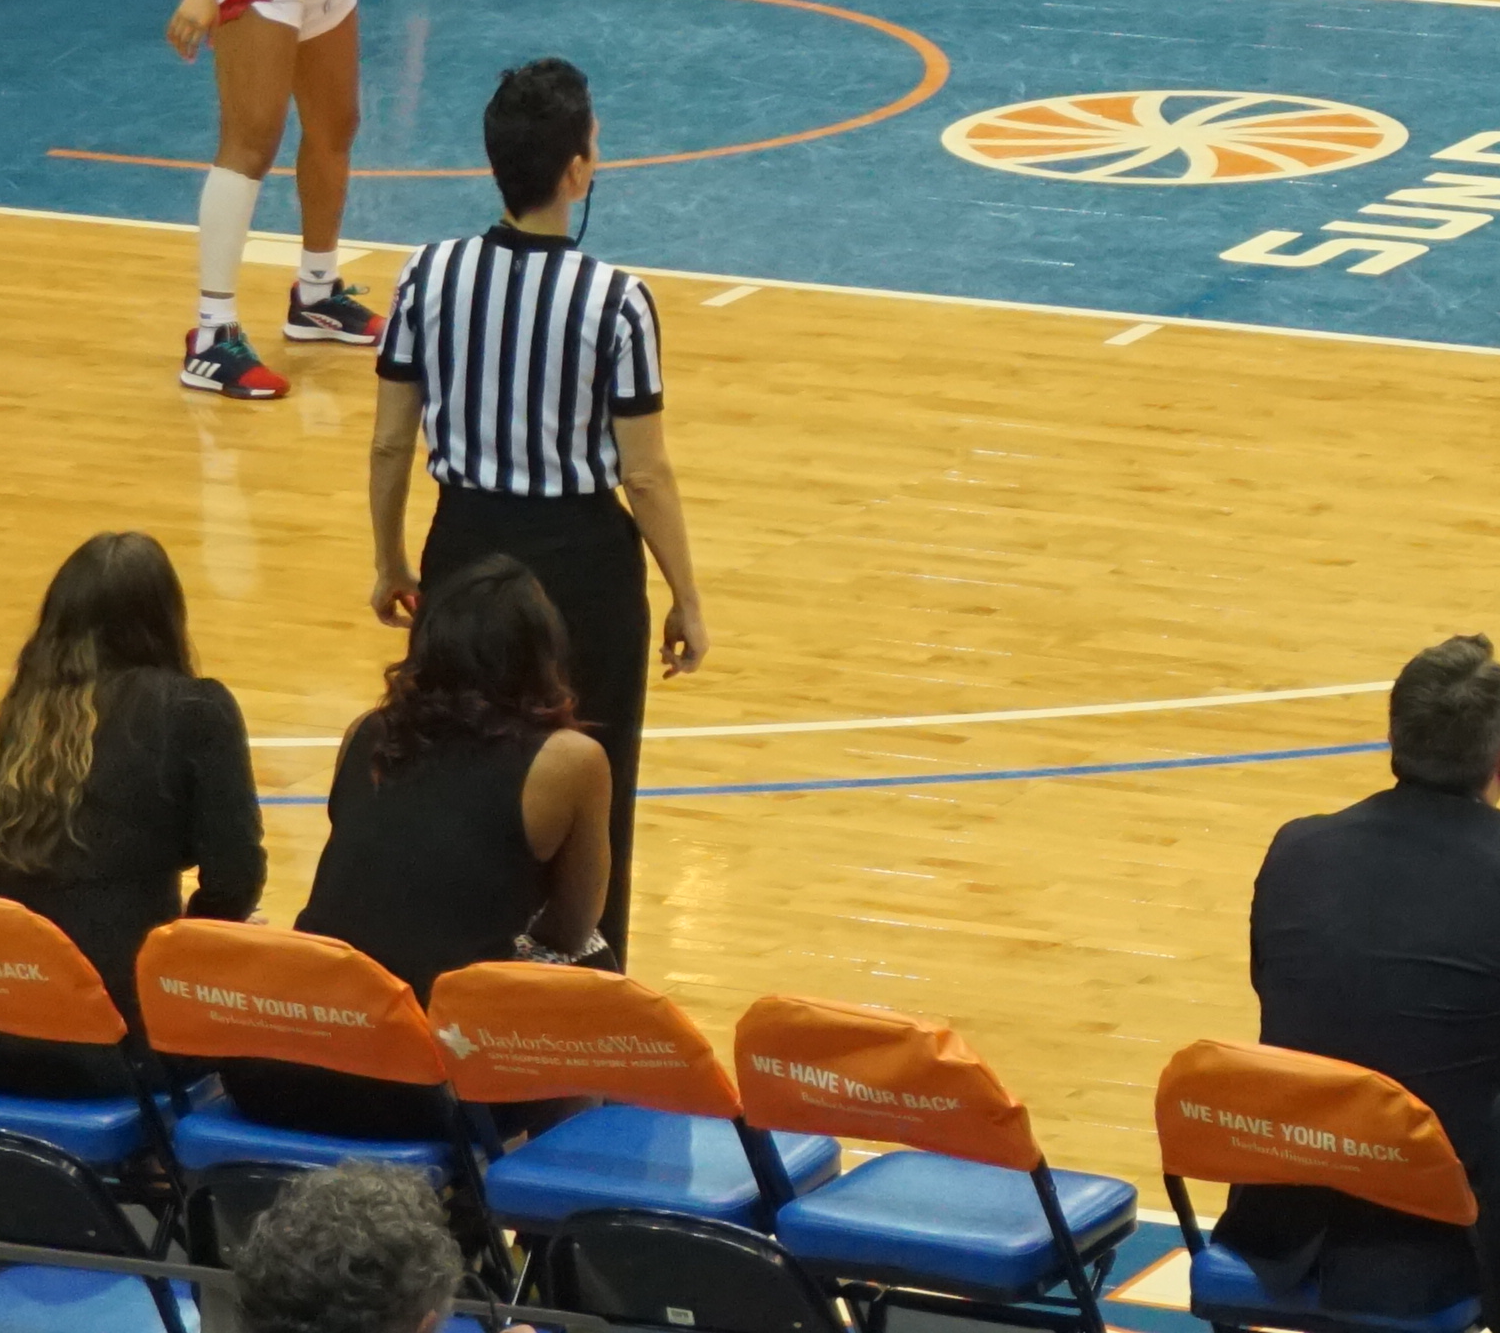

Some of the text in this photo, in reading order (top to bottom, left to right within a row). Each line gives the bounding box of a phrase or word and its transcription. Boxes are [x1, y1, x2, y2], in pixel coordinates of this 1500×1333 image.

[159, 976, 377, 1029] WE HAVE YOUR BACK.
[751, 1053, 786, 1078] WE
[789, 1061, 840, 1095] HAVE
[843, 1078, 899, 1107] YOUR
[1179, 1099, 1411, 1163] WE HAVE YOUR BACK.
